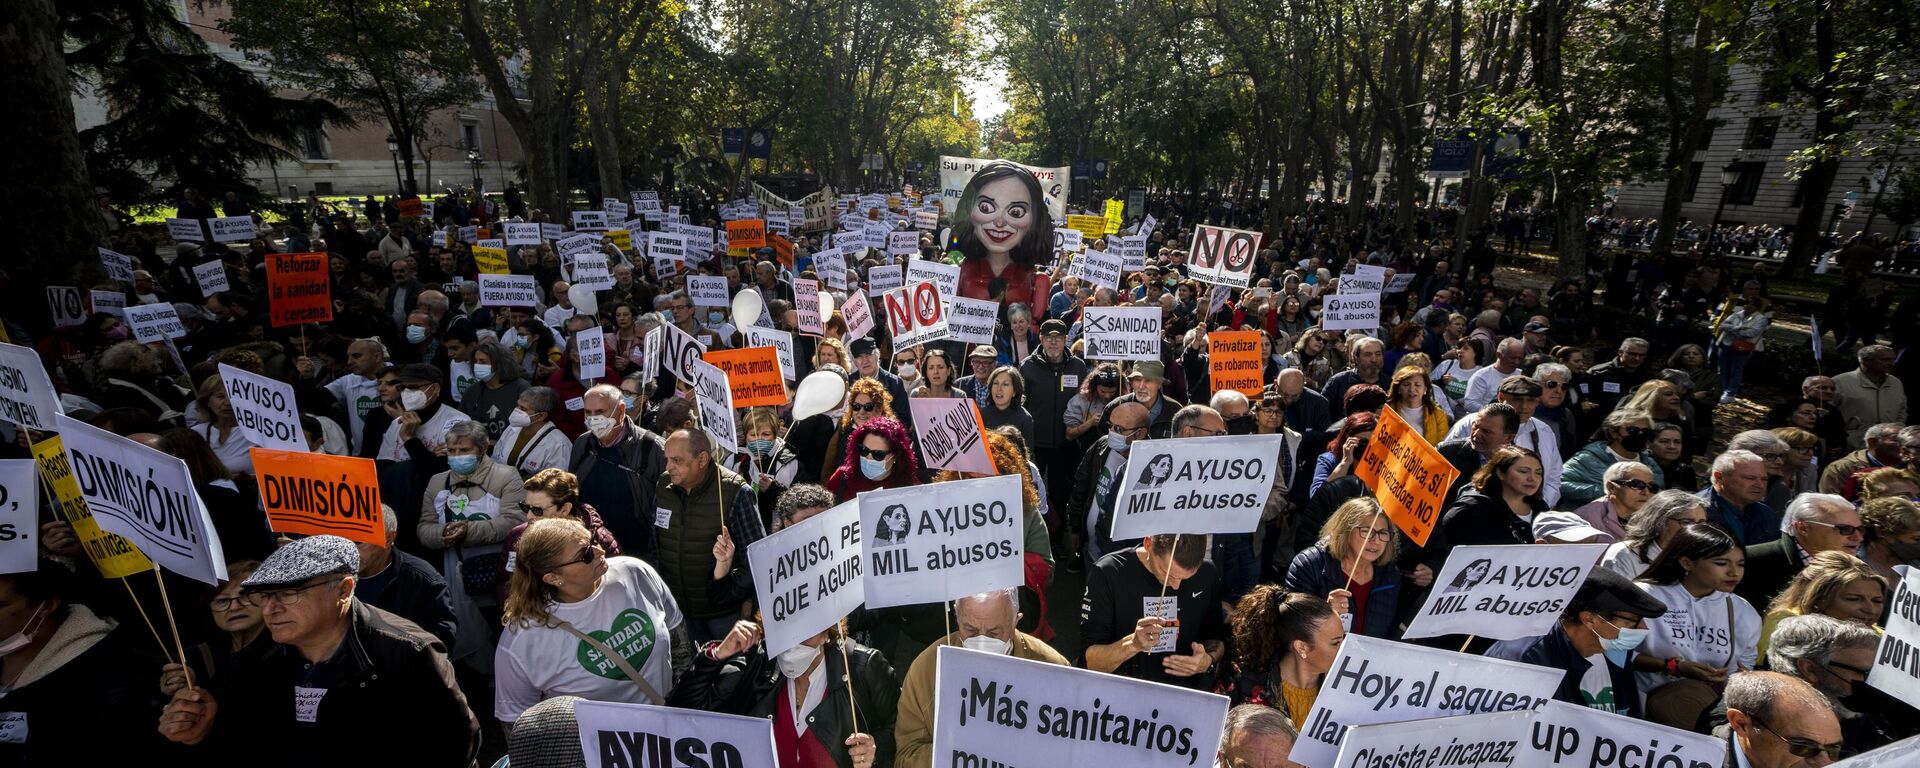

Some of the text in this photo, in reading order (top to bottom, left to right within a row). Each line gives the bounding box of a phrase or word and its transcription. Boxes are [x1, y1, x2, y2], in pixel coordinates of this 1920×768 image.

[943, 161, 958, 171] SU
[729, 228, 764, 241] DIMISIÓN!
[1191, 225, 1257, 272] NO
[276, 256, 320, 273] Reforzar
[1086, 256, 1119, 274] Con AYUSO
[273, 279, 327, 298] la sanidad
[483, 280, 506, 289] Clasista
[690, 290, 702, 298] MIL
[50, 289, 82, 319] NO
[484, 292, 535, 302] FUERA AYUSO YA!
[886, 282, 941, 337] NO
[951, 302, 995, 320] ¡Más sanitarios,
[1326, 312, 1378, 321] MIL abusos.
[137, 325, 158, 338] FUERA
[949, 323, 994, 336] muy necesarios!
[1107, 316, 1160, 336] SANIDAD,
[894, 336, 917, 351] Recortes
[1100, 339, 1159, 355] CRIMEN LEGAL!
[1213, 339, 1257, 353] Privatizar
[734, 362, 748, 376] nos
[749, 356, 774, 374] arruina
[1214, 357, 1259, 372] es robarnos
[752, 380, 785, 399] Primaria.
[1215, 377, 1261, 391] lo nuestro.
[226, 378, 292, 418] ¡AYUSO,
[236, 406, 297, 443] ABUSO!
[1377, 423, 1404, 463] Sanidad
[1400, 446, 1429, 490] Pública,
[70, 448, 197, 544] DIMISIÓN!
[1364, 445, 1377, 471] Ley
[1375, 459, 1416, 515] privatizadora,
[1415, 499, 1432, 527] NO.
[264, 474, 378, 523] DIMISIÓN!
[1126, 489, 1262, 515] MIL abusos.
[769, 535, 834, 594] ¡AYUSO,
[871, 539, 1019, 577] MIL abusos.
[772, 582, 810, 622] QUE
[1428, 594, 1565, 616] MIL abusos.
[586, 620, 643, 663] SNIDAD
[596, 634, 653, 676] PULICA
[1878, 634, 1911, 674] por
[1330, 655, 1549, 716] Hoy, al saquear
[959, 677, 1198, 767] ¡Más sanitarios,
[597, 729, 745, 768] AYUSO
[1350, 737, 1518, 768] Clasista e incapaz,
[1531, 721, 1580, 764] up
